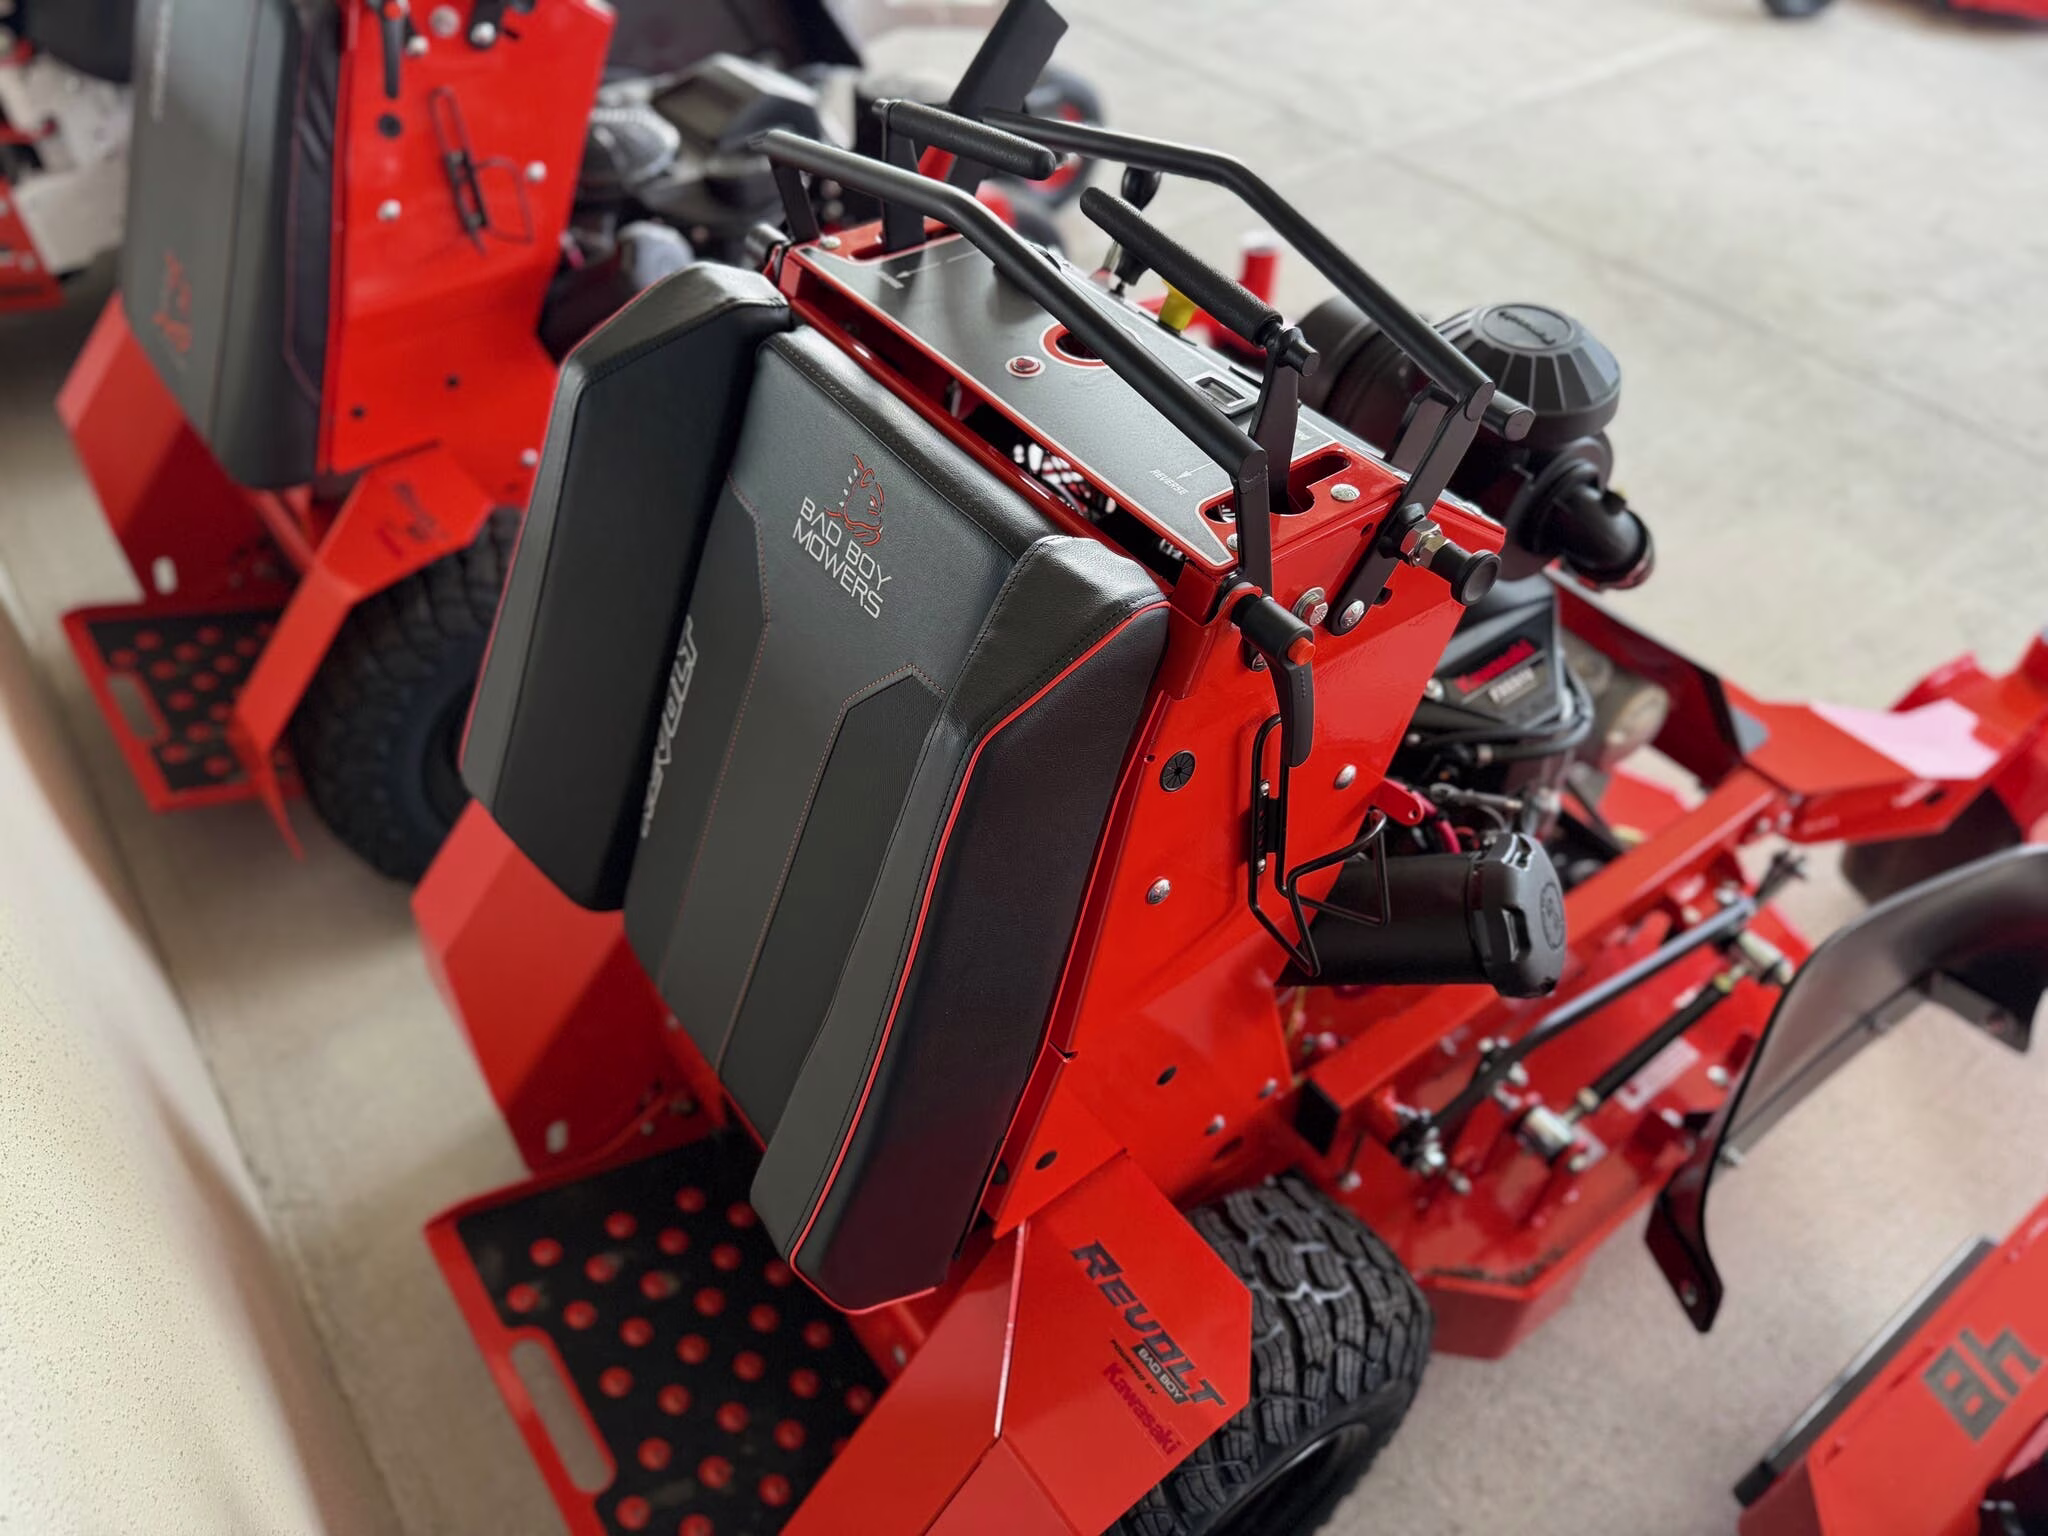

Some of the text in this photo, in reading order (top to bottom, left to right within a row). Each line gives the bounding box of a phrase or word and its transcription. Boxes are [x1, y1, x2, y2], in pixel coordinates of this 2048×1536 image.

[1149, 469, 1189, 496] REVERSE
[792, 518, 884, 619] MOWERS
[800, 496, 892, 591] BAD BOY
[1070, 1239, 1227, 1407] REVOLT
[1110, 1339, 1158, 1395] POWERED BY
[1102, 1362, 1182, 1456] Kawasaki
[1138, 1347, 1184, 1398] BAD BOY
